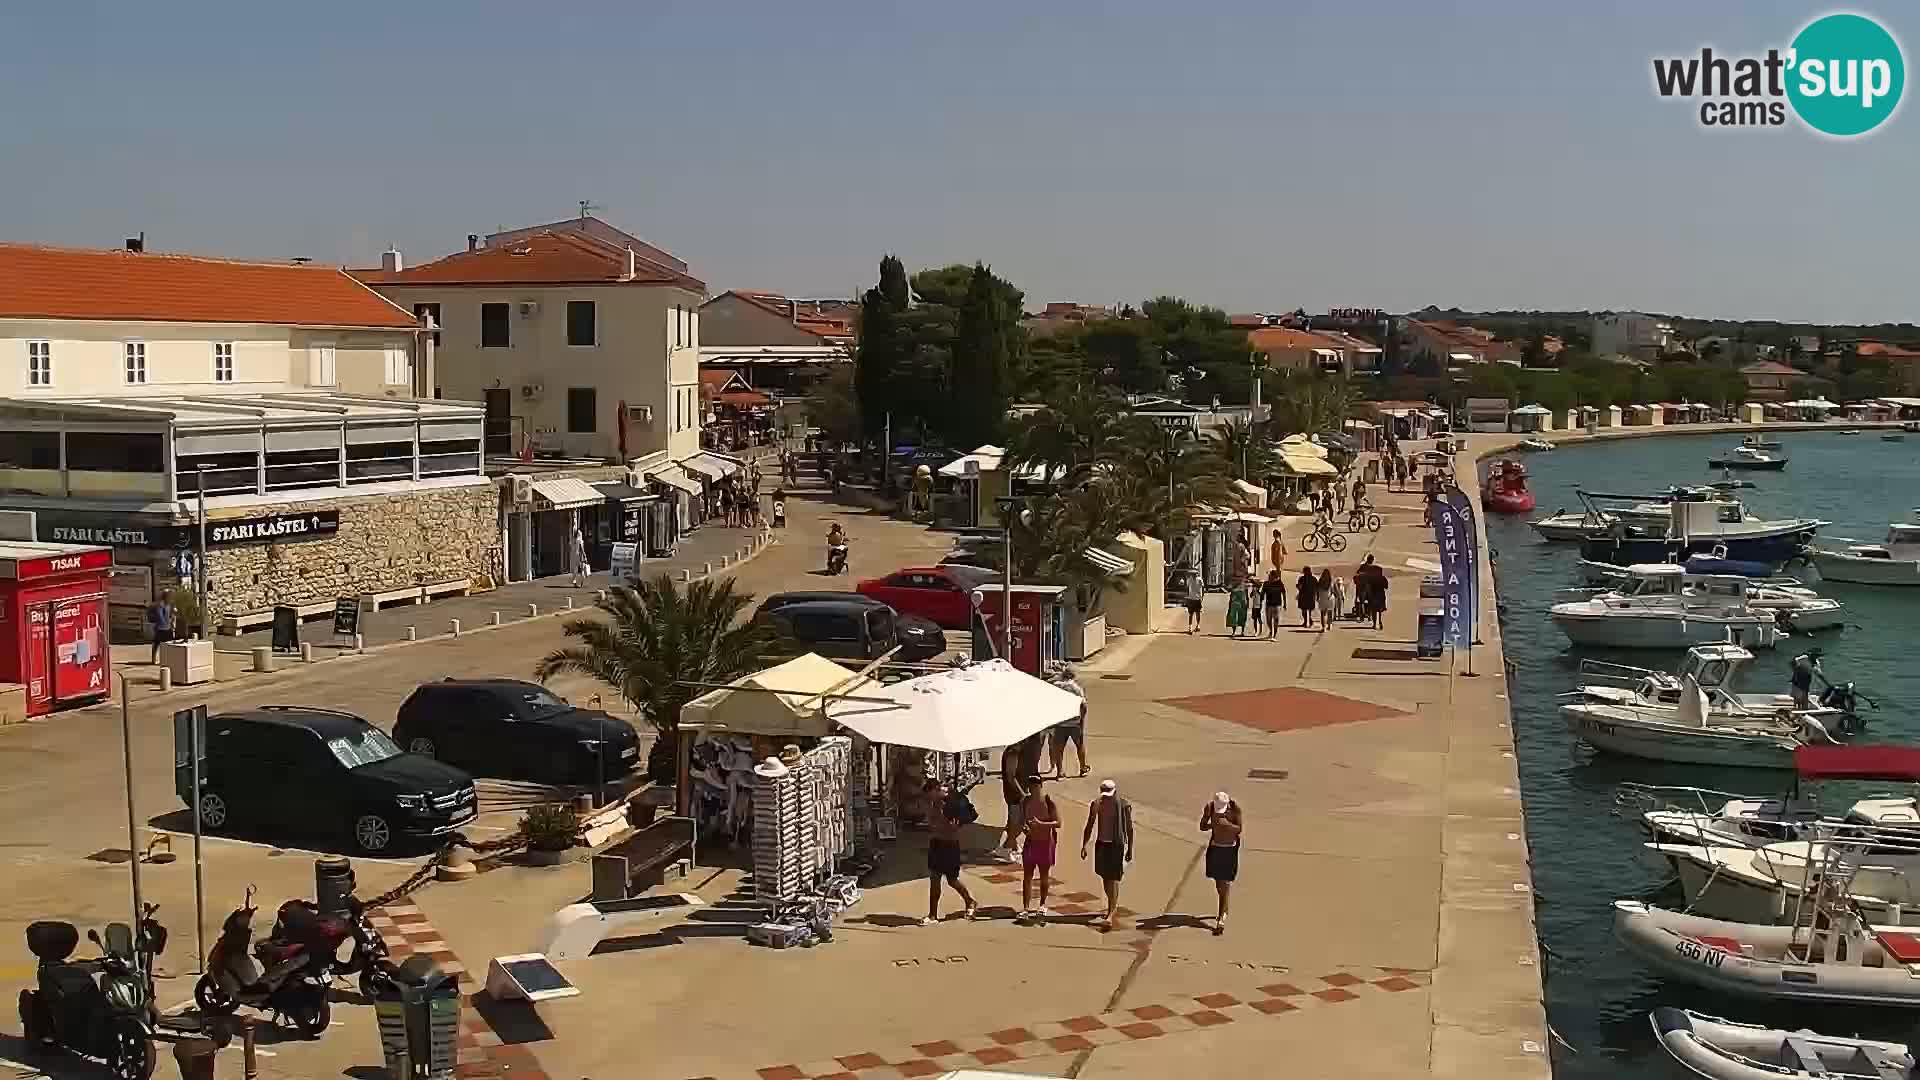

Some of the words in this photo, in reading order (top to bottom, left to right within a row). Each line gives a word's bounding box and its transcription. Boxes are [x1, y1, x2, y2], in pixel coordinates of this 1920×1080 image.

[53, 527, 91, 541] STARI
[95, 528, 148, 545] KAŠTEL
[212, 526, 254, 542] STARI
[256, 516, 308, 537] KAŠTEL
[50, 556, 81, 571] TISAK
[30, 610, 49, 624] Buy
[90, 667, 103, 688] A1
[1675, 941, 1700, 960] 456
[1704, 949, 1726, 968] NV
